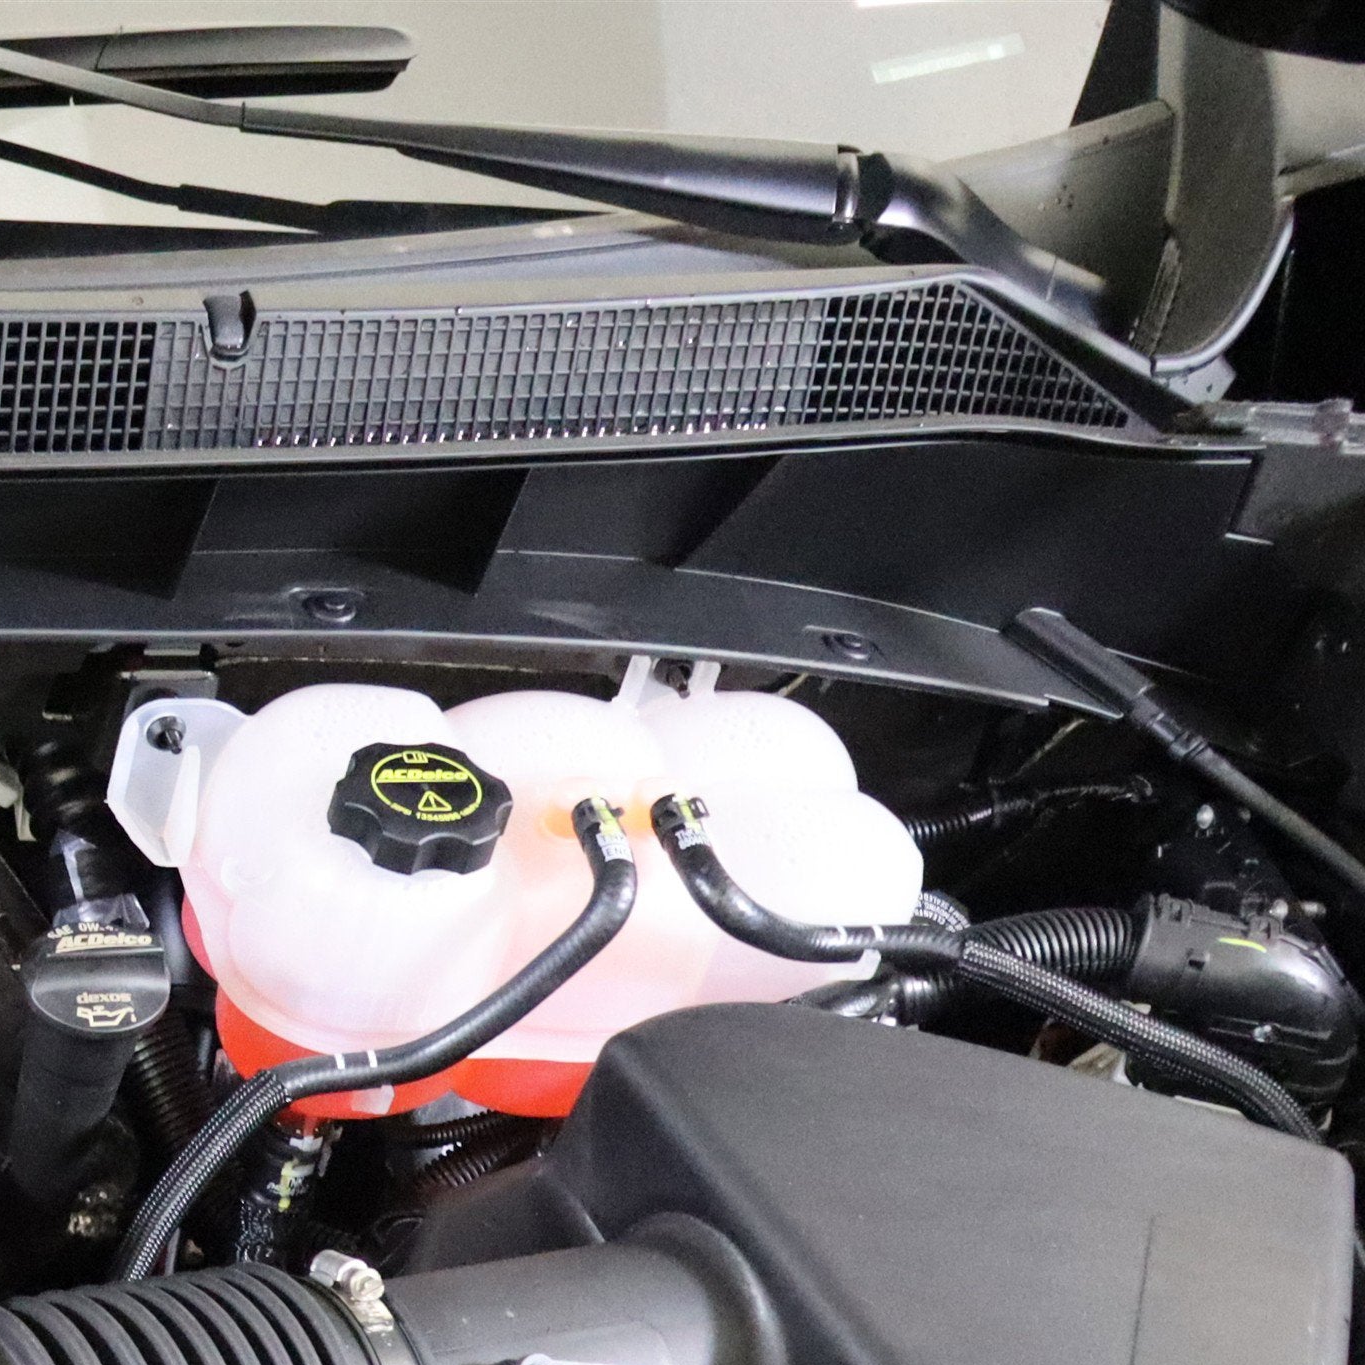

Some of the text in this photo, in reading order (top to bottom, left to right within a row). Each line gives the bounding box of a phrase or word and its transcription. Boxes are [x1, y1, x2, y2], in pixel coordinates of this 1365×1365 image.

[376, 768, 469, 783] ACDelco
[47, 924, 74, 940] SAE
[55, 932, 153, 953] ACDelco
[76, 991, 132, 1004] dexos
